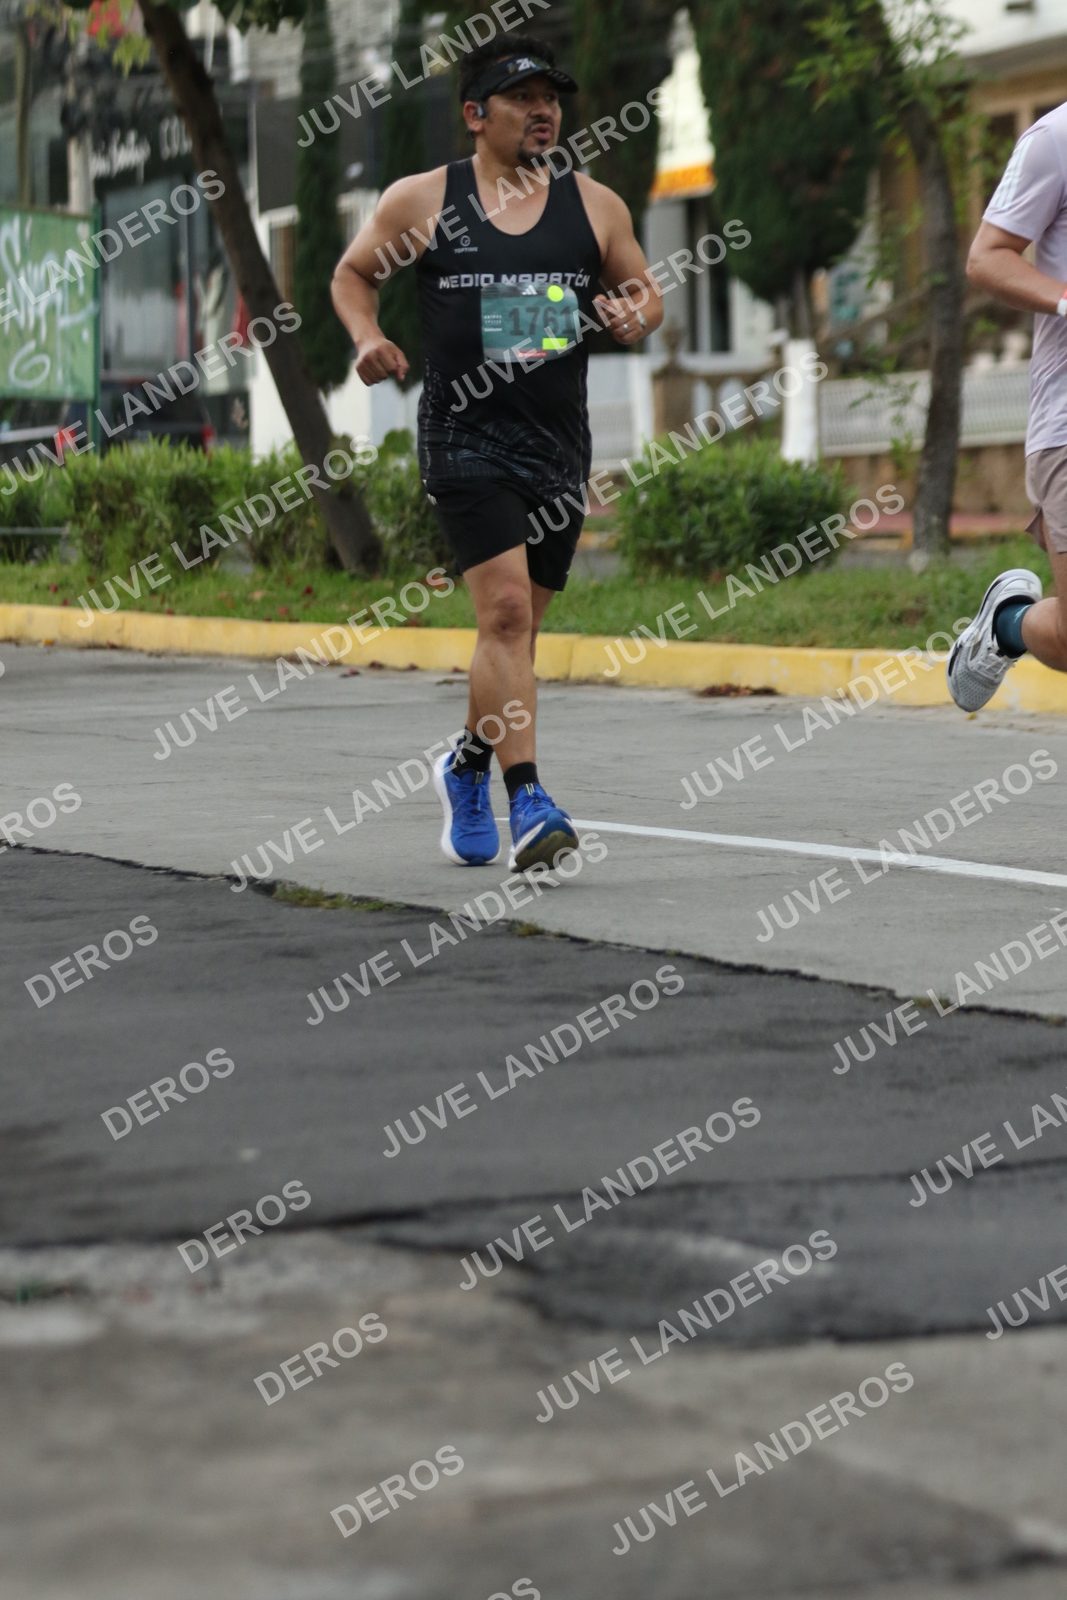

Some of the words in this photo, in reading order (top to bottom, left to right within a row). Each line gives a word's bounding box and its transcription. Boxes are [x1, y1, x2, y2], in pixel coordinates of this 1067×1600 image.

[439, 273, 495, 289] MEDIO
[501, 268, 592, 287] MARATÓN
[508, 304, 576, 336] 1761
